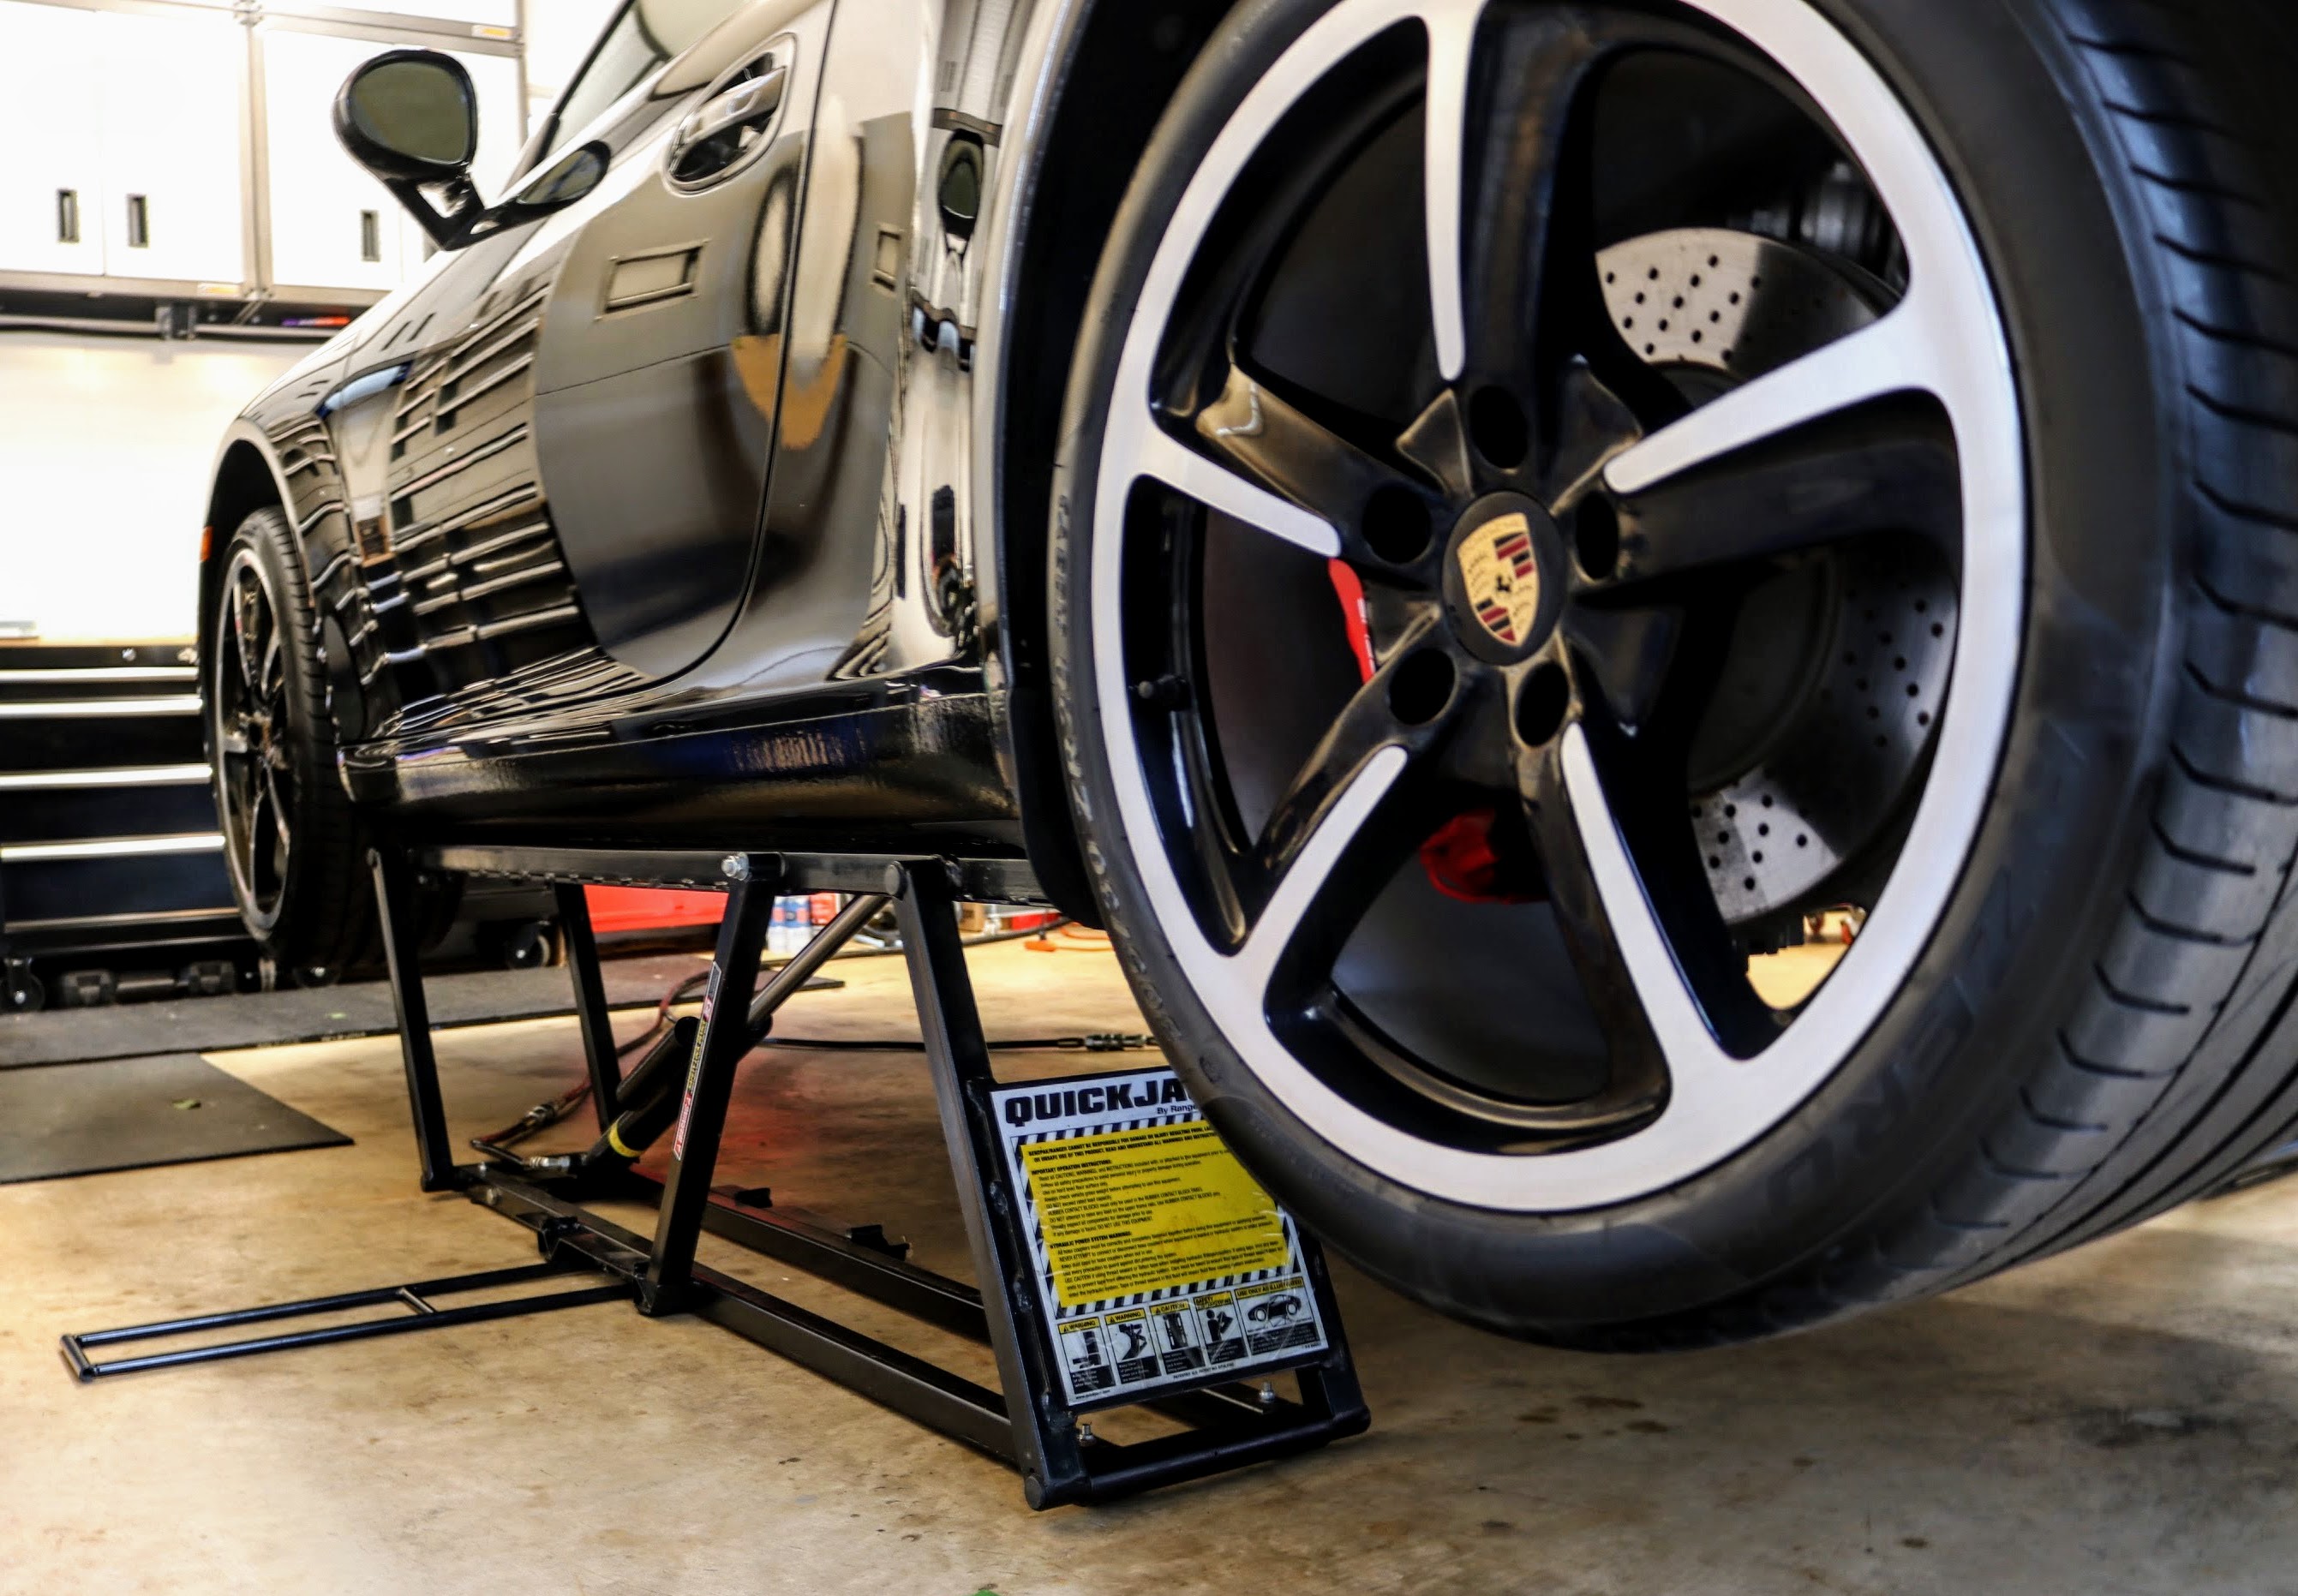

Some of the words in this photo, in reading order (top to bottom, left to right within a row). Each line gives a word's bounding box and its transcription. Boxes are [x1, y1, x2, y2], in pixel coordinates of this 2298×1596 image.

[1004, 1078, 1192, 1127] QUICKJA
[1156, 1106, 1169, 1115] By
[1170, 1103, 1195, 1113] Range
[1092, 1139, 1120, 1147] RESPONSIBLE
[1127, 1140, 1153, 1149] UNDERSTAND
[1056, 1163, 1080, 1172] OPERATION
[1050, 1240, 1074, 1249] HYDRAULIC
[1160, 1302, 1186, 1312] CAUTION
[1115, 1312, 1141, 1321] WARNING
[1069, 1320, 1096, 1330] WARNING
